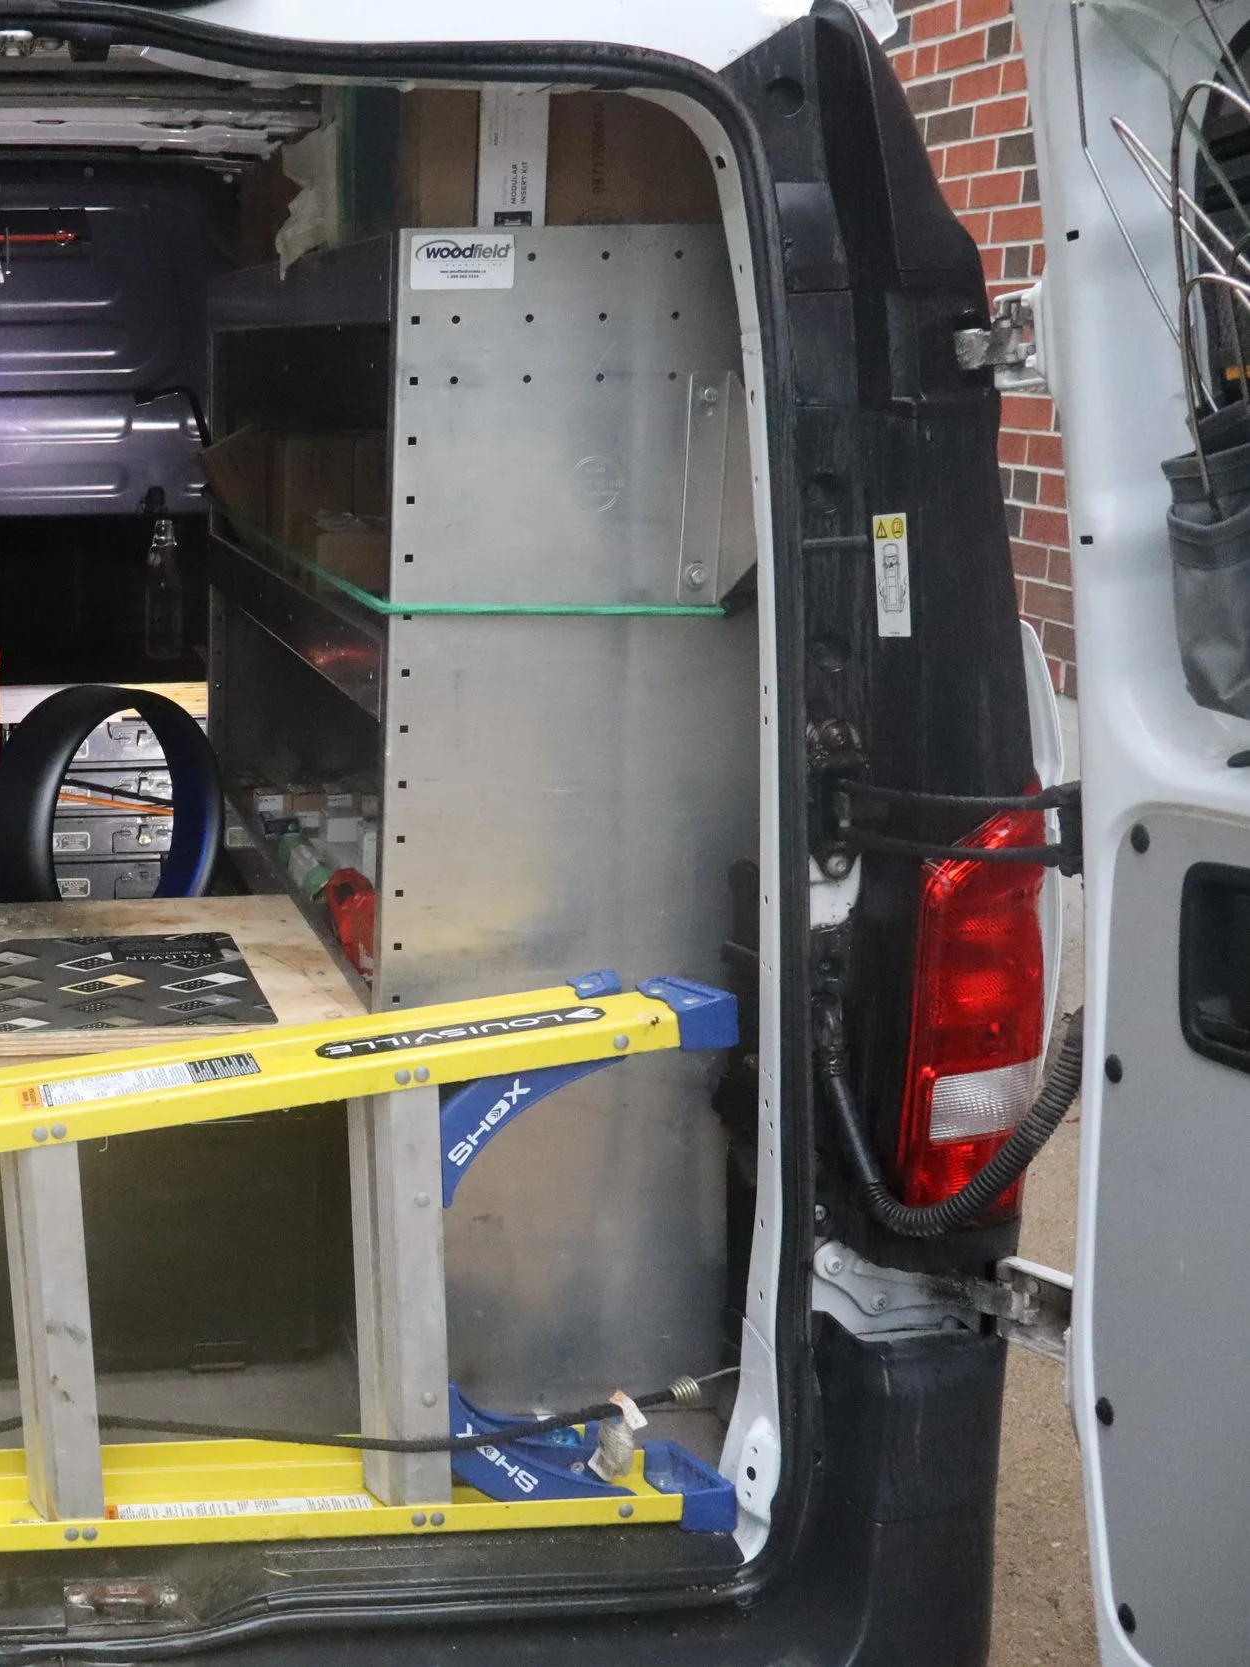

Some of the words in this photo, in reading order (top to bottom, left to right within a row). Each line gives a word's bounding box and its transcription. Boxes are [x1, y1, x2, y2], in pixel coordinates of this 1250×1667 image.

[510, 164, 518, 205] MODULAR
[426, 243, 512, 259] woodfield
[125, 953, 212, 961] BALDWIN
[325, 1013, 564, 1055] LOUISVILLE
[447, 1078, 531, 1166] SHOX
